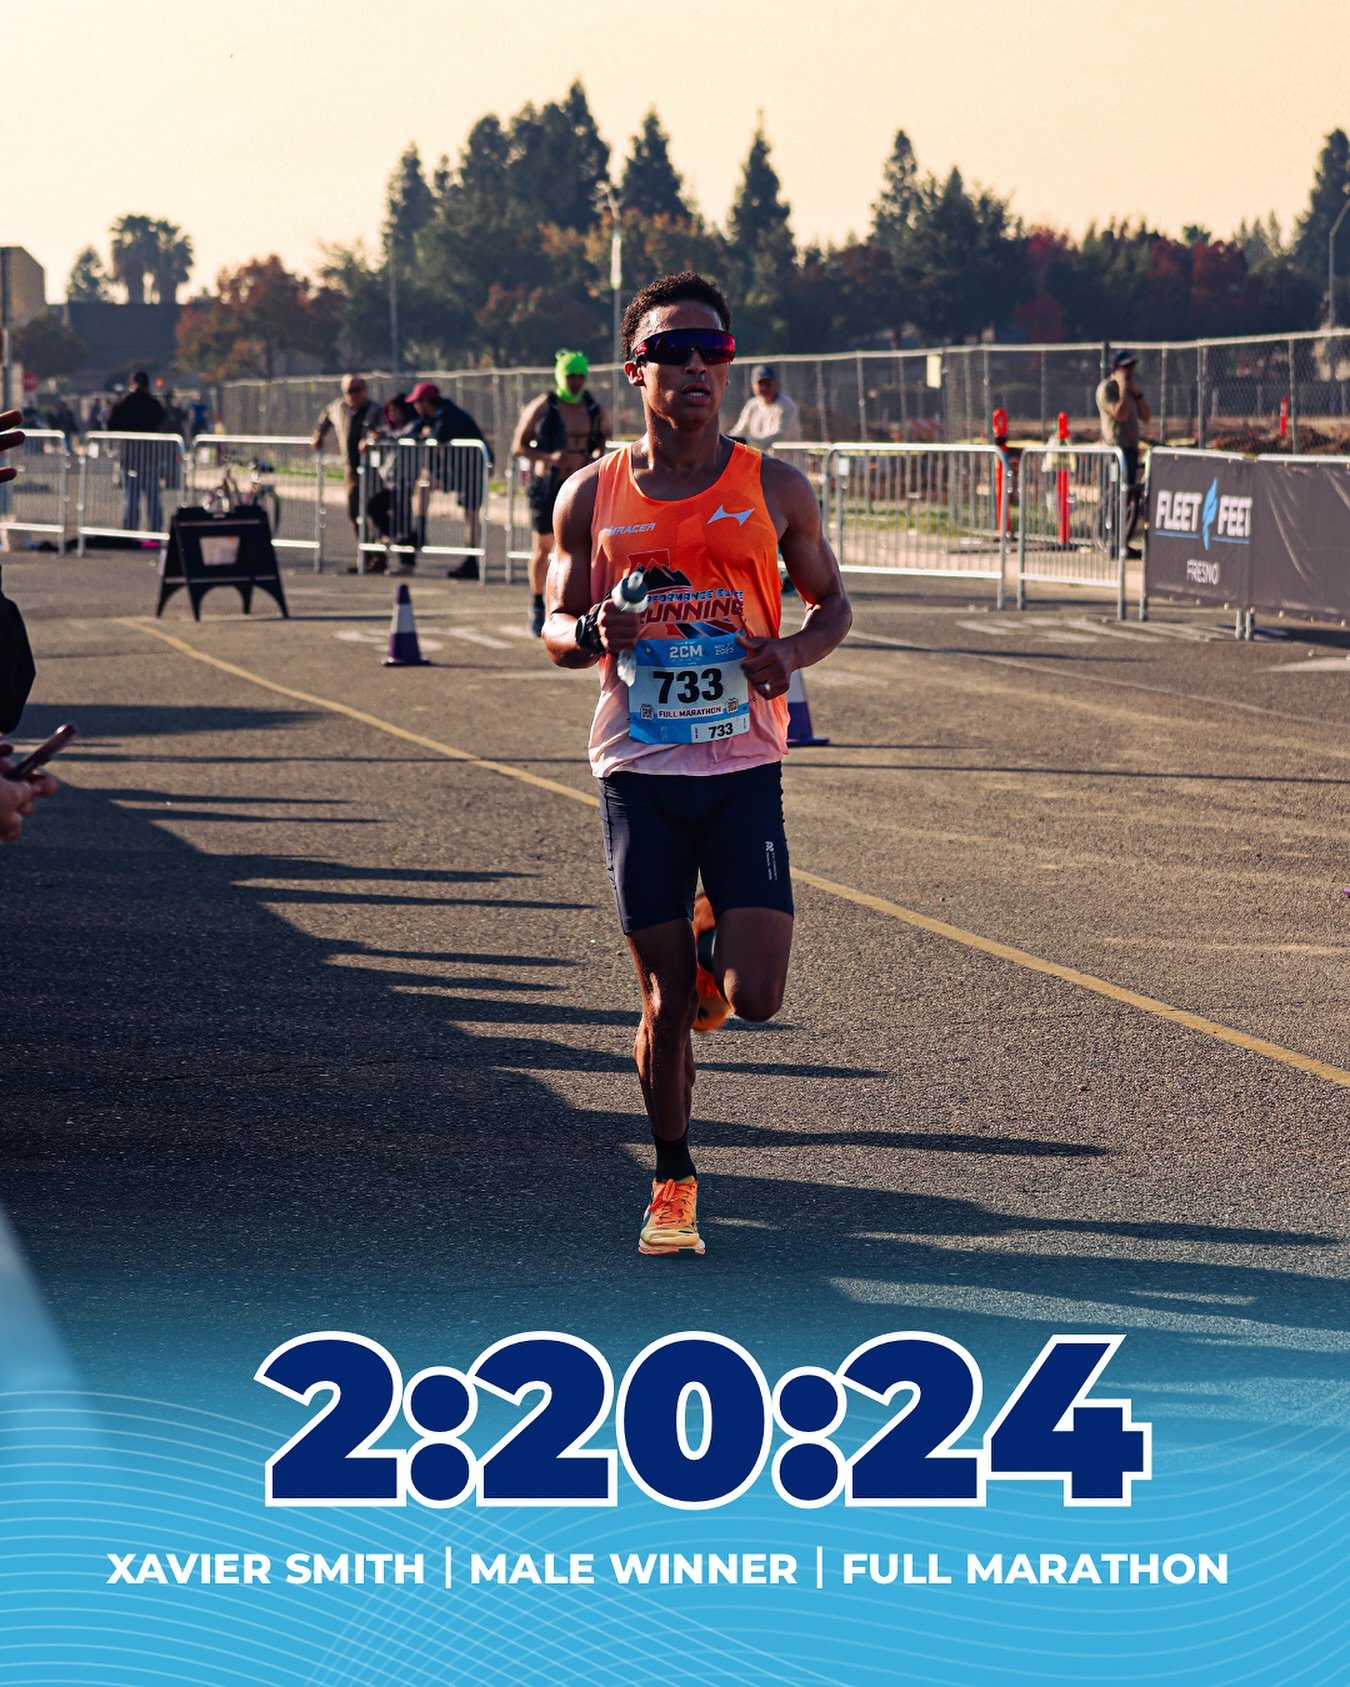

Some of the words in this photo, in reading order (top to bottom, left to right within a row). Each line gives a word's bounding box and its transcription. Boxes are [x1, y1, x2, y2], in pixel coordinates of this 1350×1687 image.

[1155, 490, 1202, 532] FLEET
[1217, 495, 1252, 537] FEET
[1186, 559, 1220, 585] FRESNO
[648, 590, 713, 603] RFORMANCE
[669, 644, 703, 658] 2CM
[653, 668, 723, 704] 733
[659, 709, 678, 718] FULL
[679, 706, 722, 718] MARATHON
[708, 722, 733, 739] 733
